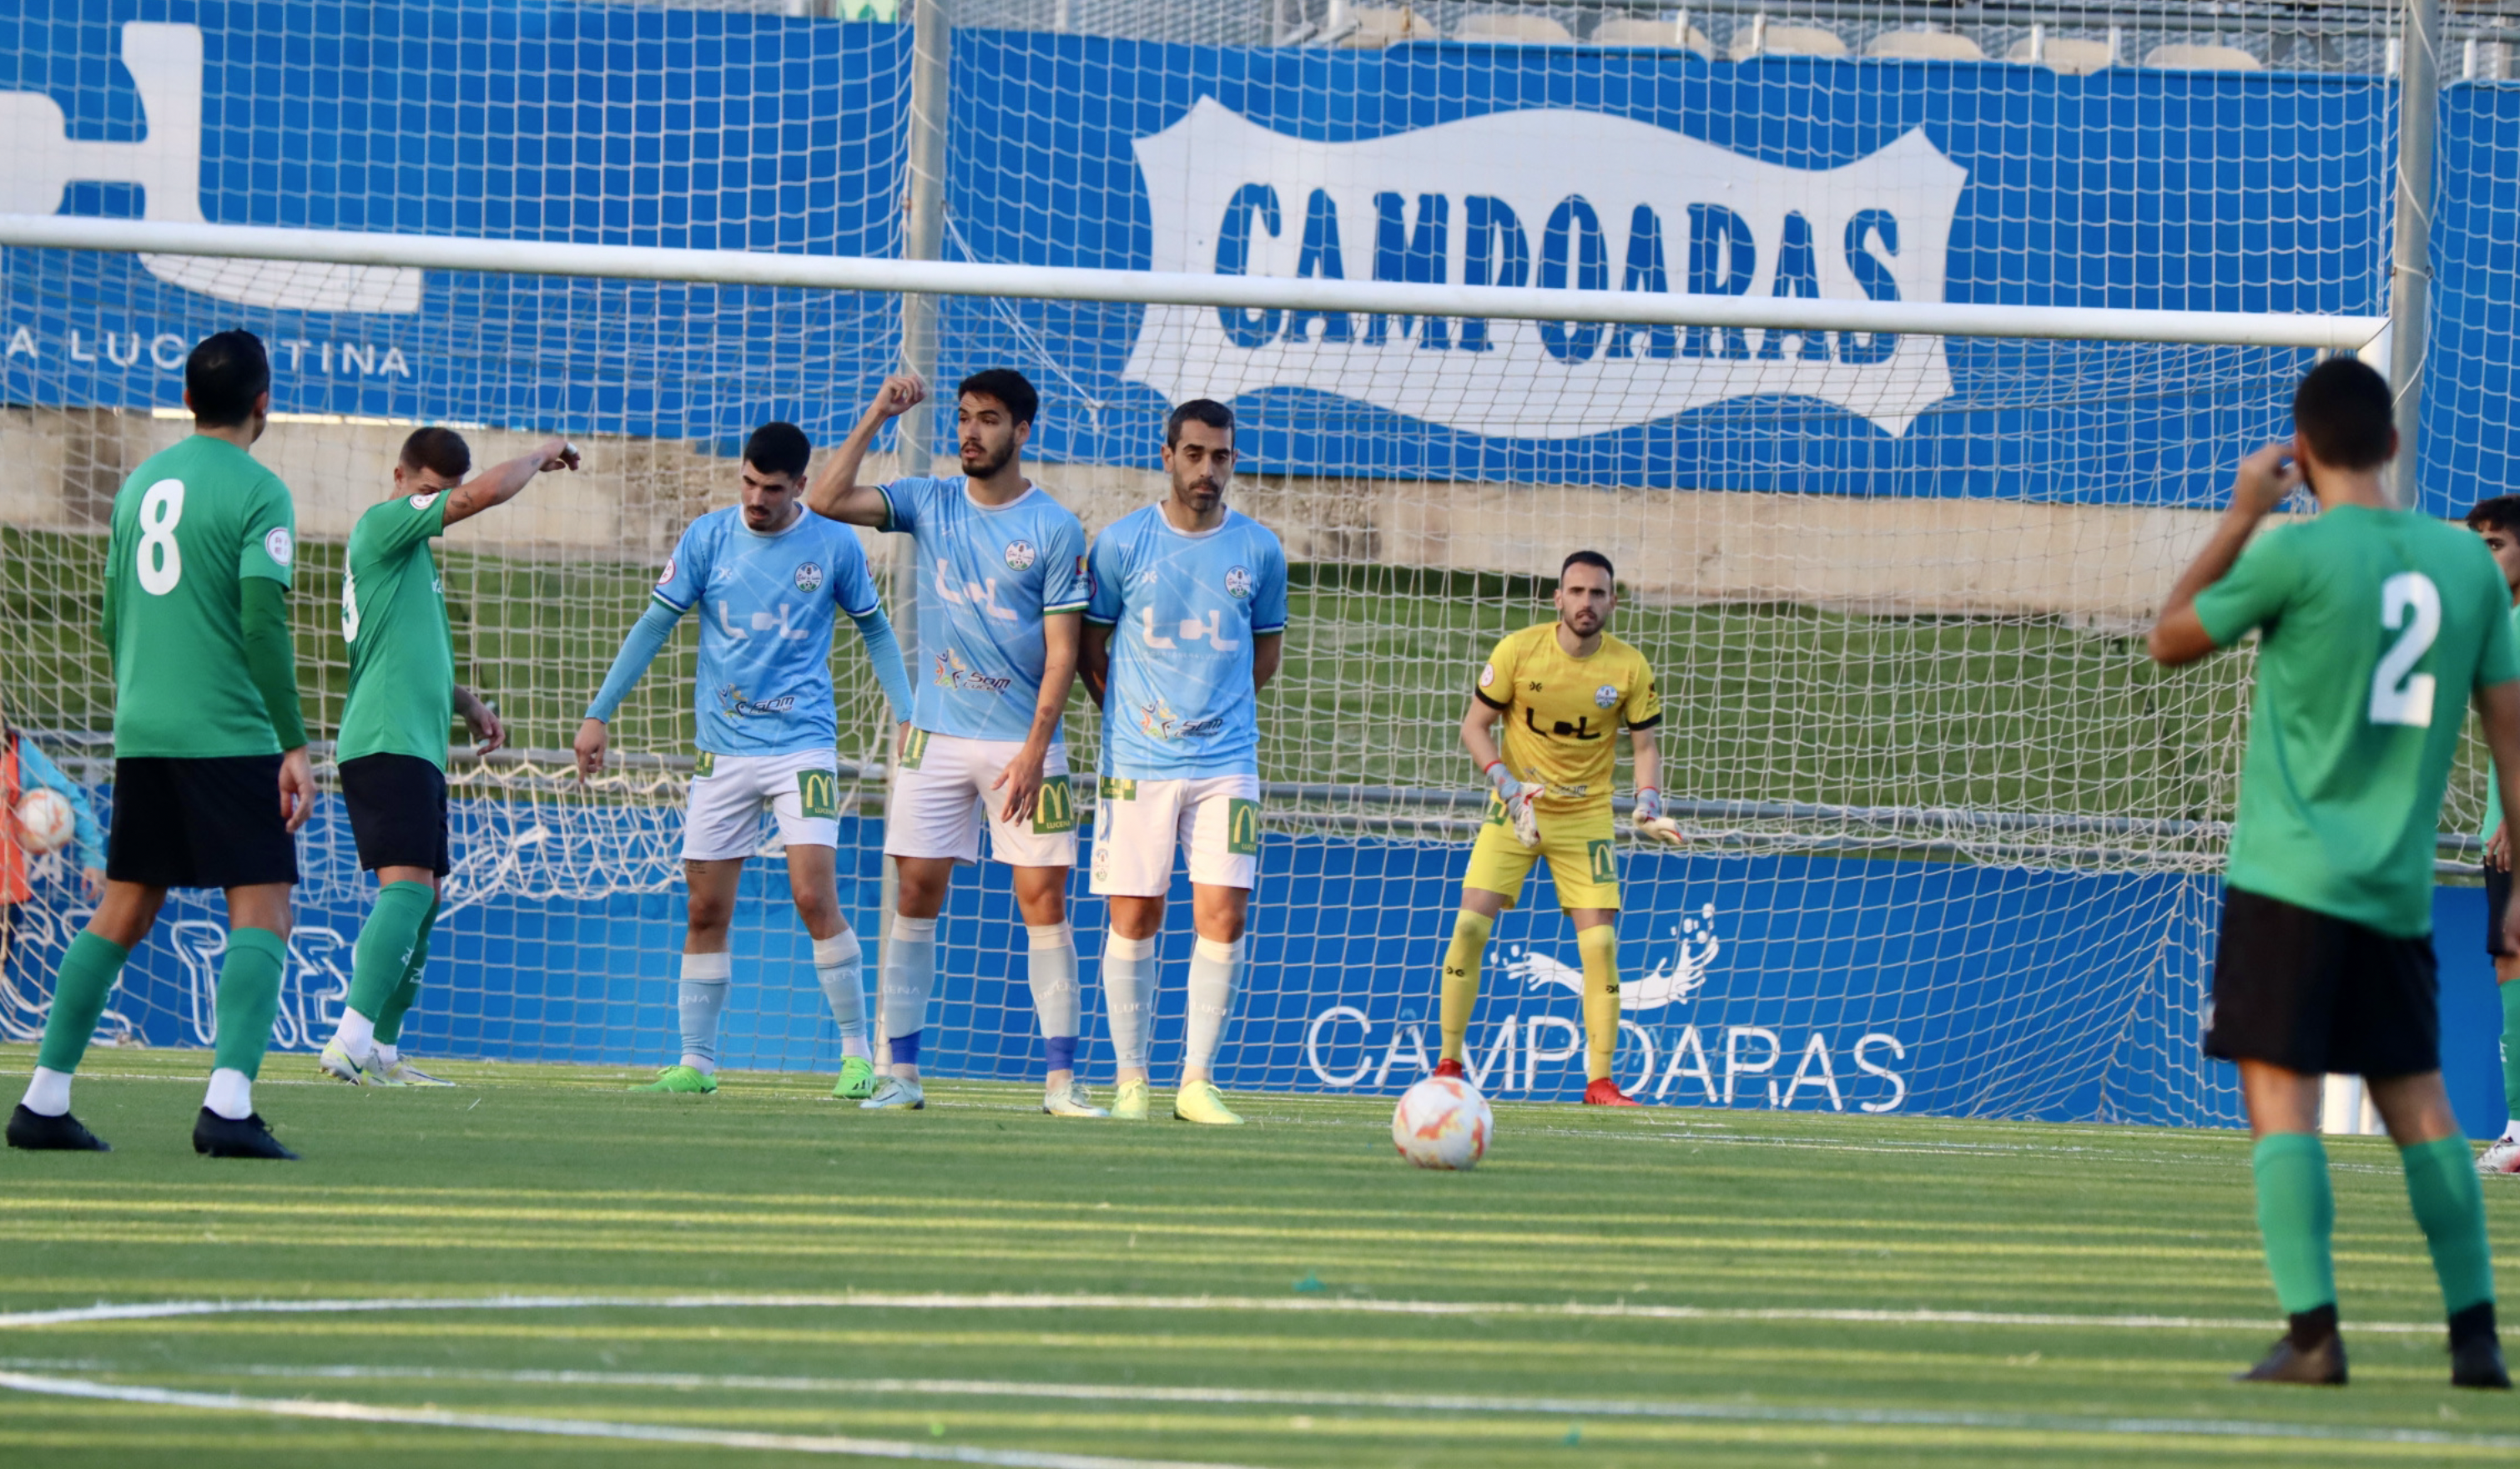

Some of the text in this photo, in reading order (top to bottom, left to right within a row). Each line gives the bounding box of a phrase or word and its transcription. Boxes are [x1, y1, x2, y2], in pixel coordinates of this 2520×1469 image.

[1214, 182, 1902, 365] CAMPOARAS
[70, 328, 411, 378] LUCTINA
[136, 477, 185, 597] 8
[2368, 571, 2442, 728] 2
[1307, 1004, 1905, 1113] CAMPOARAS
